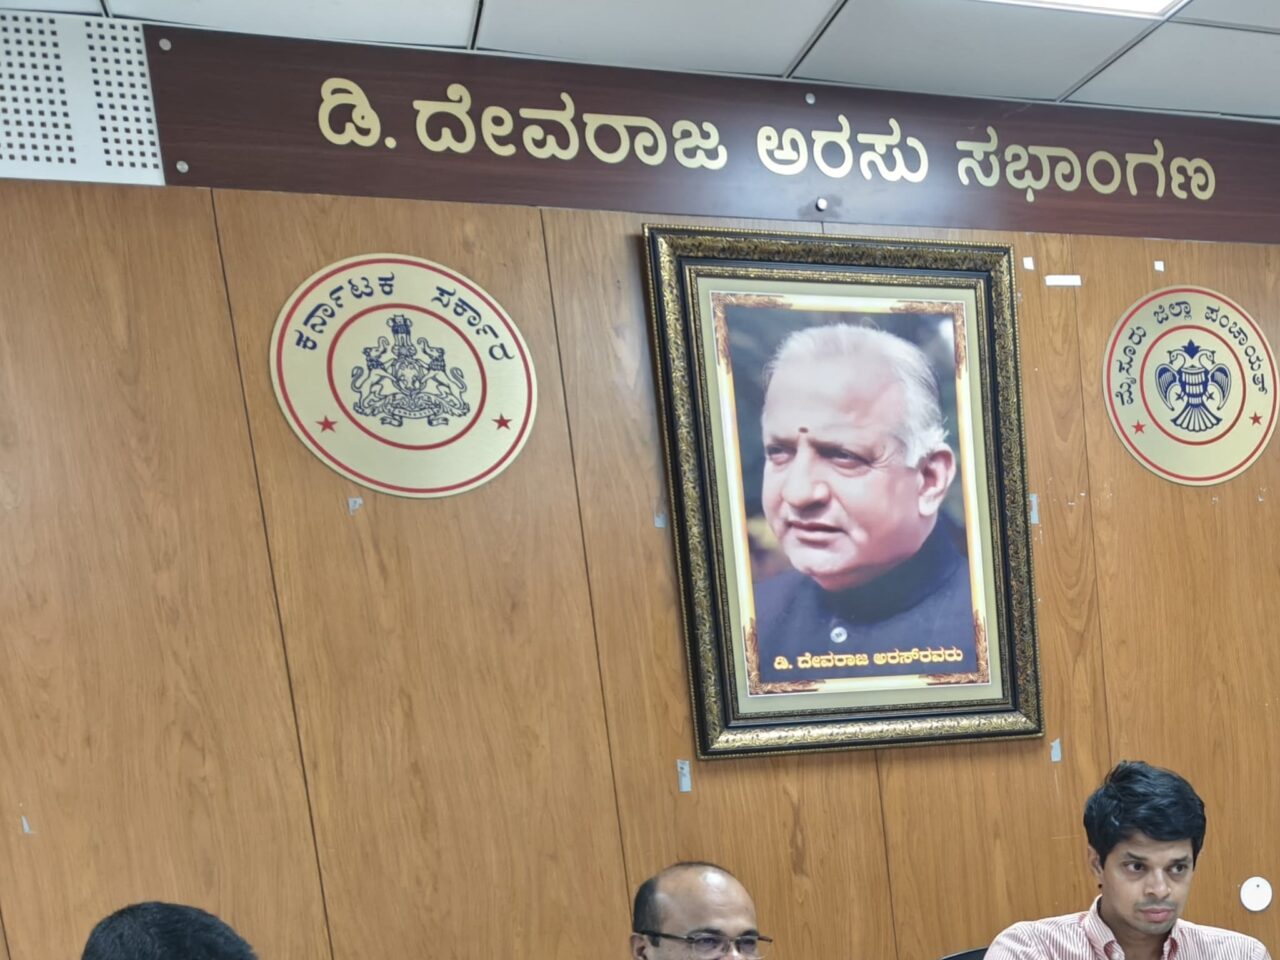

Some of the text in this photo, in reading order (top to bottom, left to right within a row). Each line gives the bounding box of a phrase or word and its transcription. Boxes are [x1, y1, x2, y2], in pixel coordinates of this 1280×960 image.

[317, 77, 1216, 202] ಡಿ. ದೇವರಾಜ ಅರಸು ಸಭಾಂಗಣ
[294, 271, 515, 361] ಕರ್ನಾಟಕ ಸರ್ಕಾರ
[1115, 301, 1268, 406] ಮೈಸೂರು ಜಿಲ್ಲಾ ಪಂಚಾಯತ್
[773, 654, 793, 671] ಡಿ.
[797, 651, 870, 669] ದೇವರಾಜ
